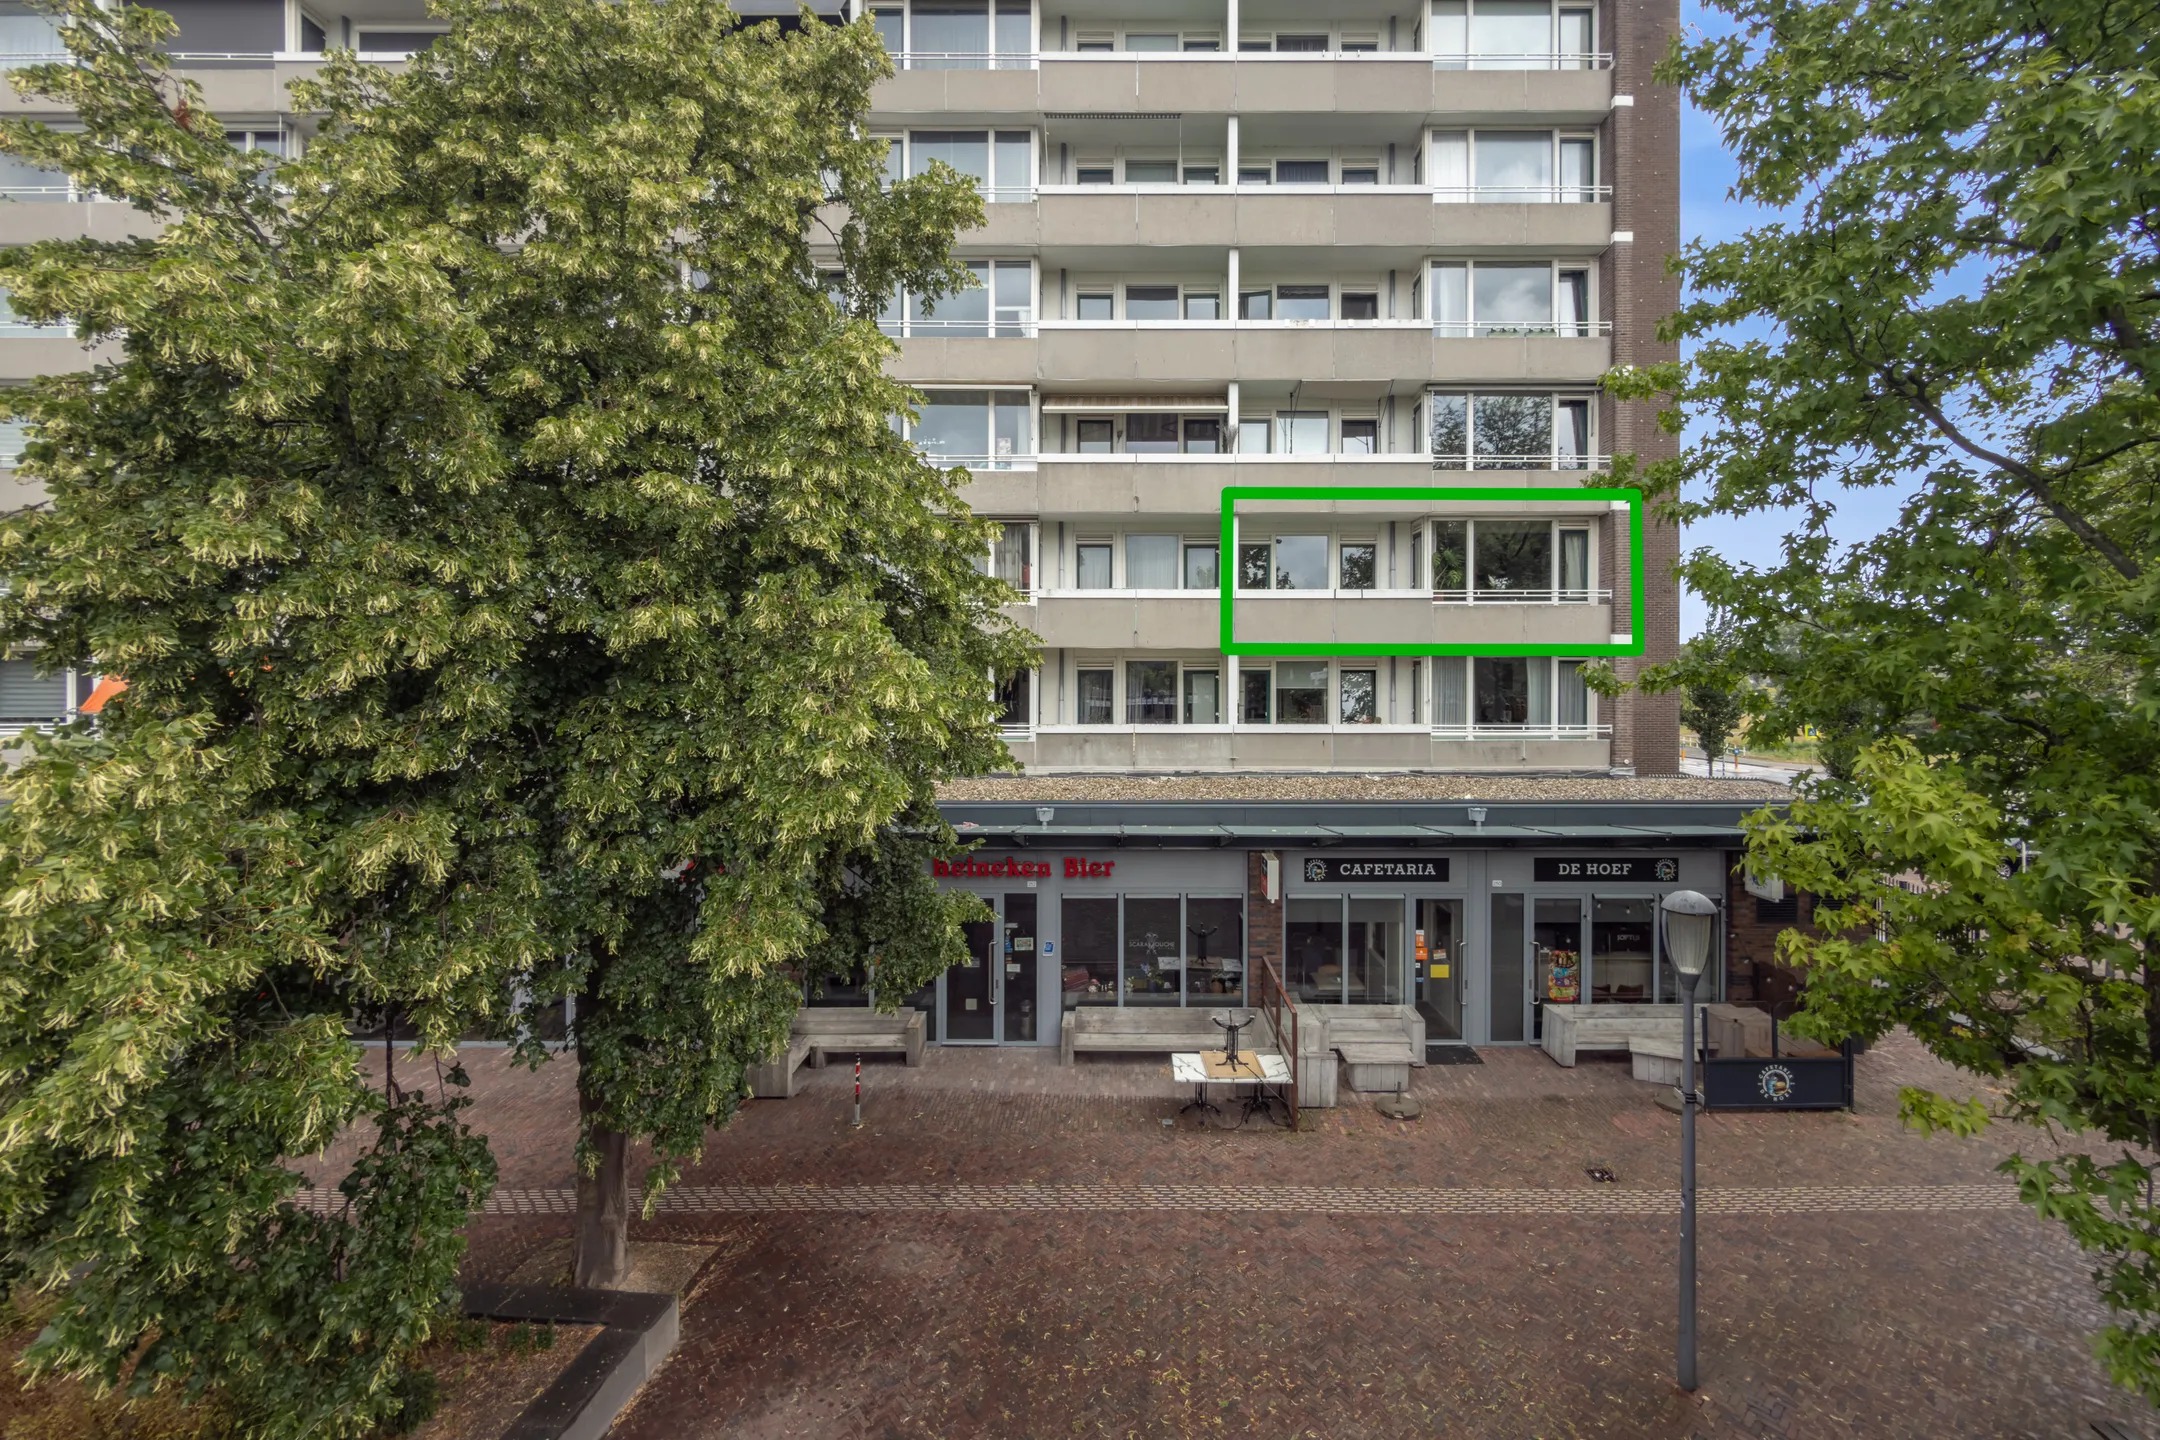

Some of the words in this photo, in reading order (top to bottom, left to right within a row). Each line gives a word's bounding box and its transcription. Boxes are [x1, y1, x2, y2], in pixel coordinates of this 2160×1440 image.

[1063, 857, 1115, 878] Bier
[1340, 863, 1436, 876] CAFETARIA
[1559, 863, 1580, 876] DE
[1587, 863, 1632, 876] HOEF
